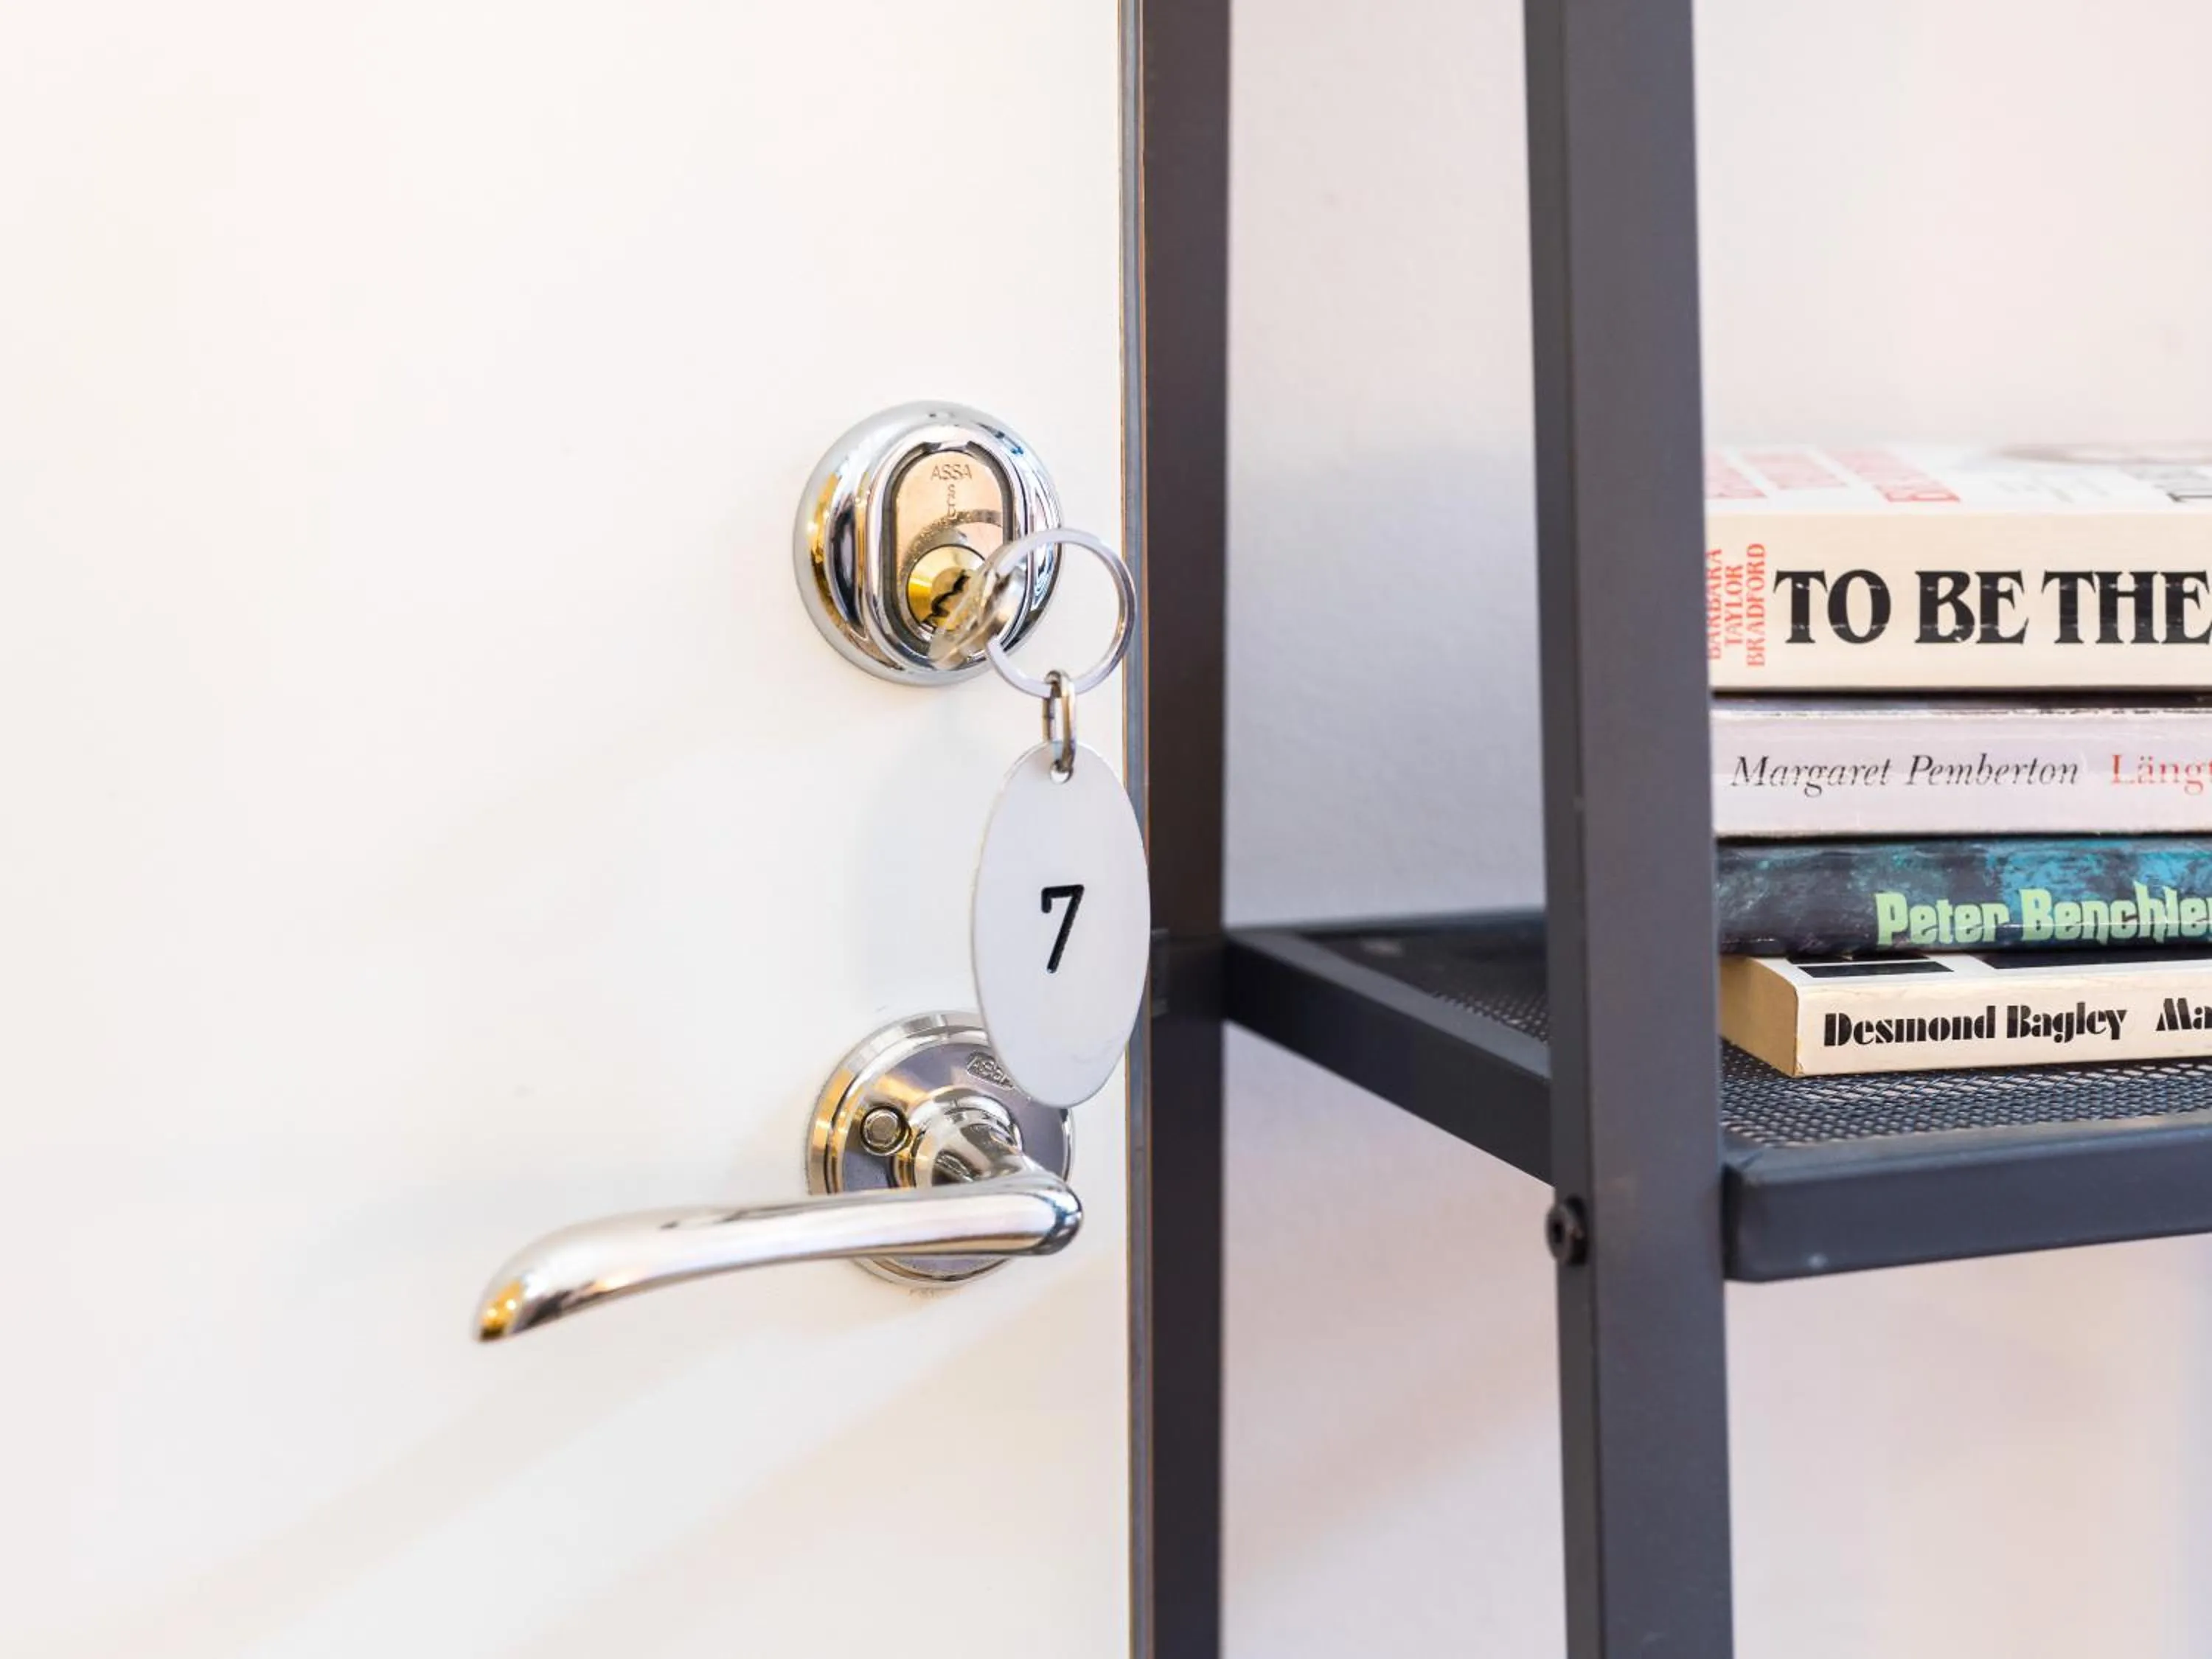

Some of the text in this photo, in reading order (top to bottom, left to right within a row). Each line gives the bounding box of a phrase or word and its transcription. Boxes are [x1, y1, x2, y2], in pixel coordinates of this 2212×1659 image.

[931, 464, 973, 481] ASSA
[1706, 549, 1722, 659] BARBARA
[1725, 565, 1744, 645] TAYLOR
[1746, 543, 1765, 666] BRADFORD
[1773, 569, 2212, 644] TO BE THE
[1731, 753, 2212, 798] Margaret Pemberton Läng
[1040, 884, 1085, 974] 7
[1875, 880, 2212, 945] Peter Benchle
[1823, 1005, 1997, 1046] Desmond
[2006, 1001, 2127, 1043] Bagley
